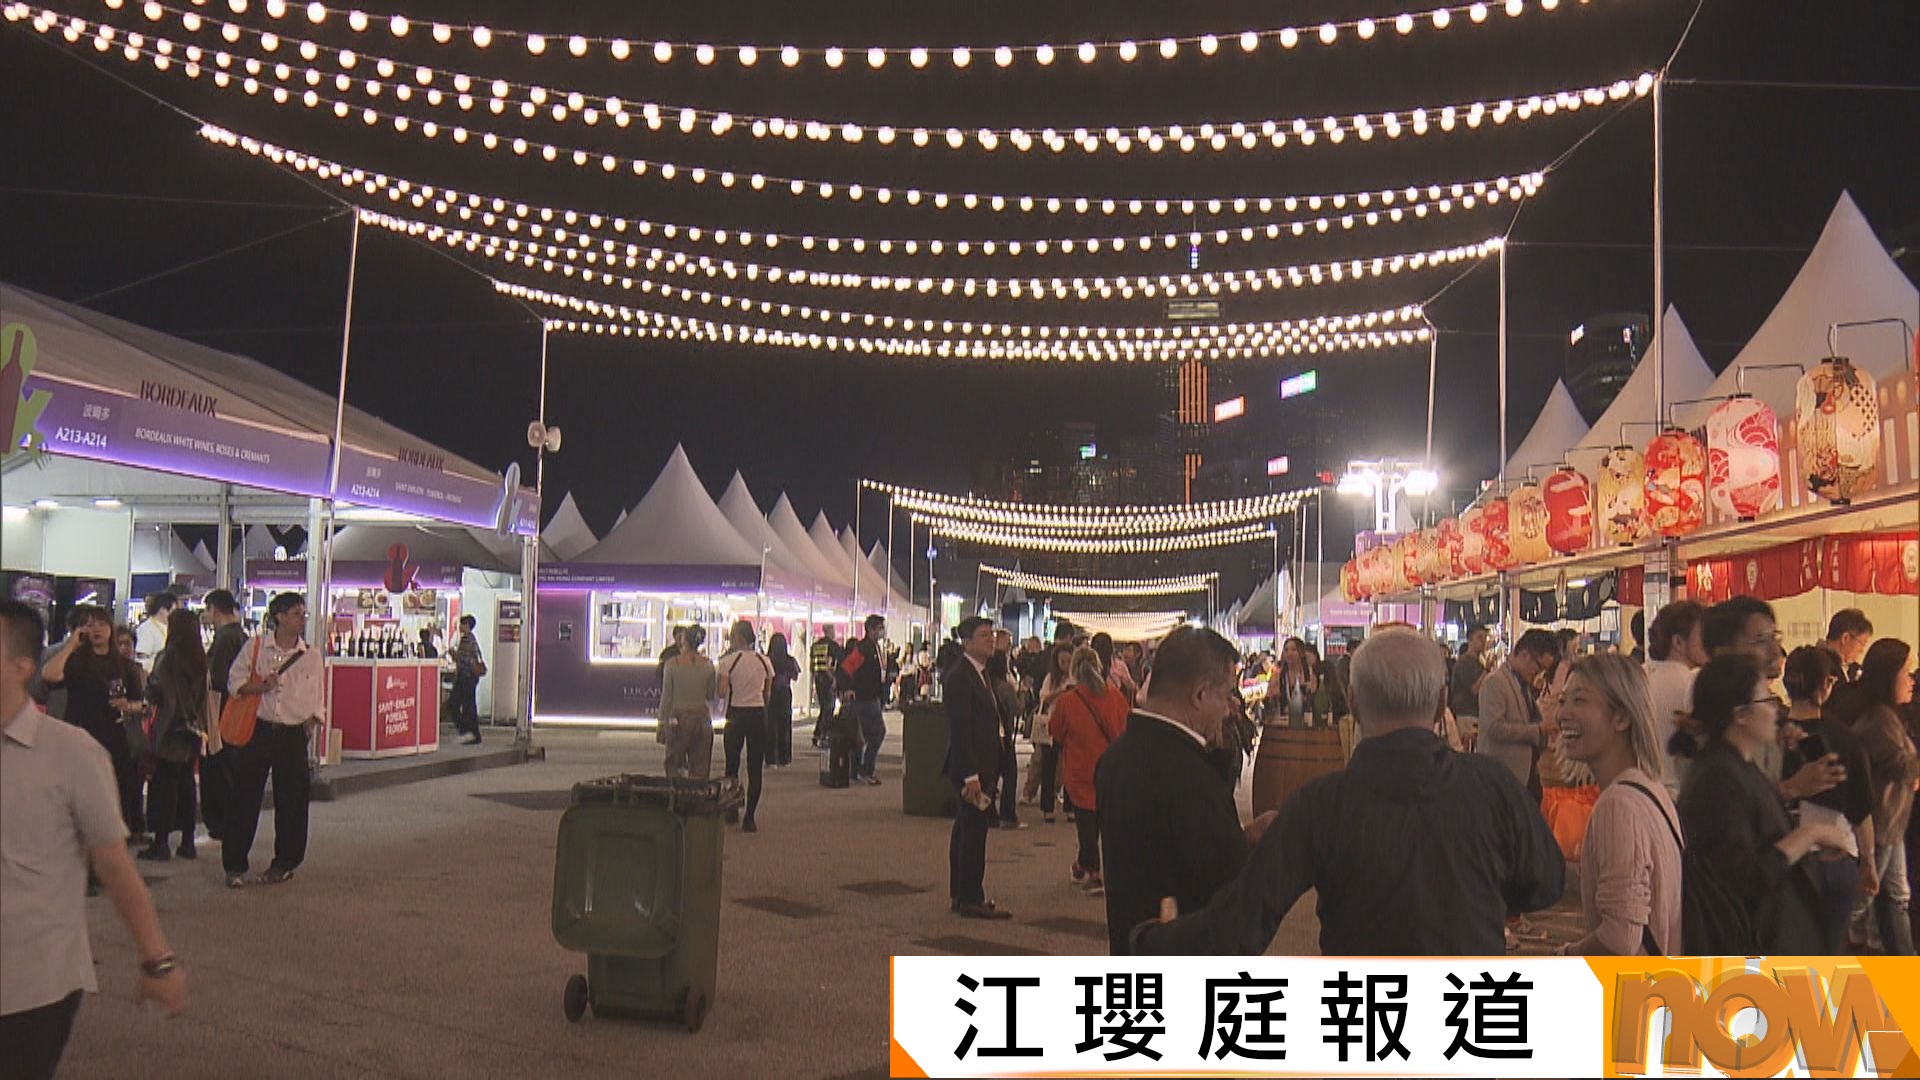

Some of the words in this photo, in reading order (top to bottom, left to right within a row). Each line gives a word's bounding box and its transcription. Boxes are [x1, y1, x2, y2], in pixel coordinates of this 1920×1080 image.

[139, 379, 219, 418] BORDEAUX
[55, 426, 108, 449] A213-A214
[135, 427, 173, 444] BORDEAUX
[173, 434, 194, 449] WHITE
[398, 446, 445, 473] BORDEAUX
